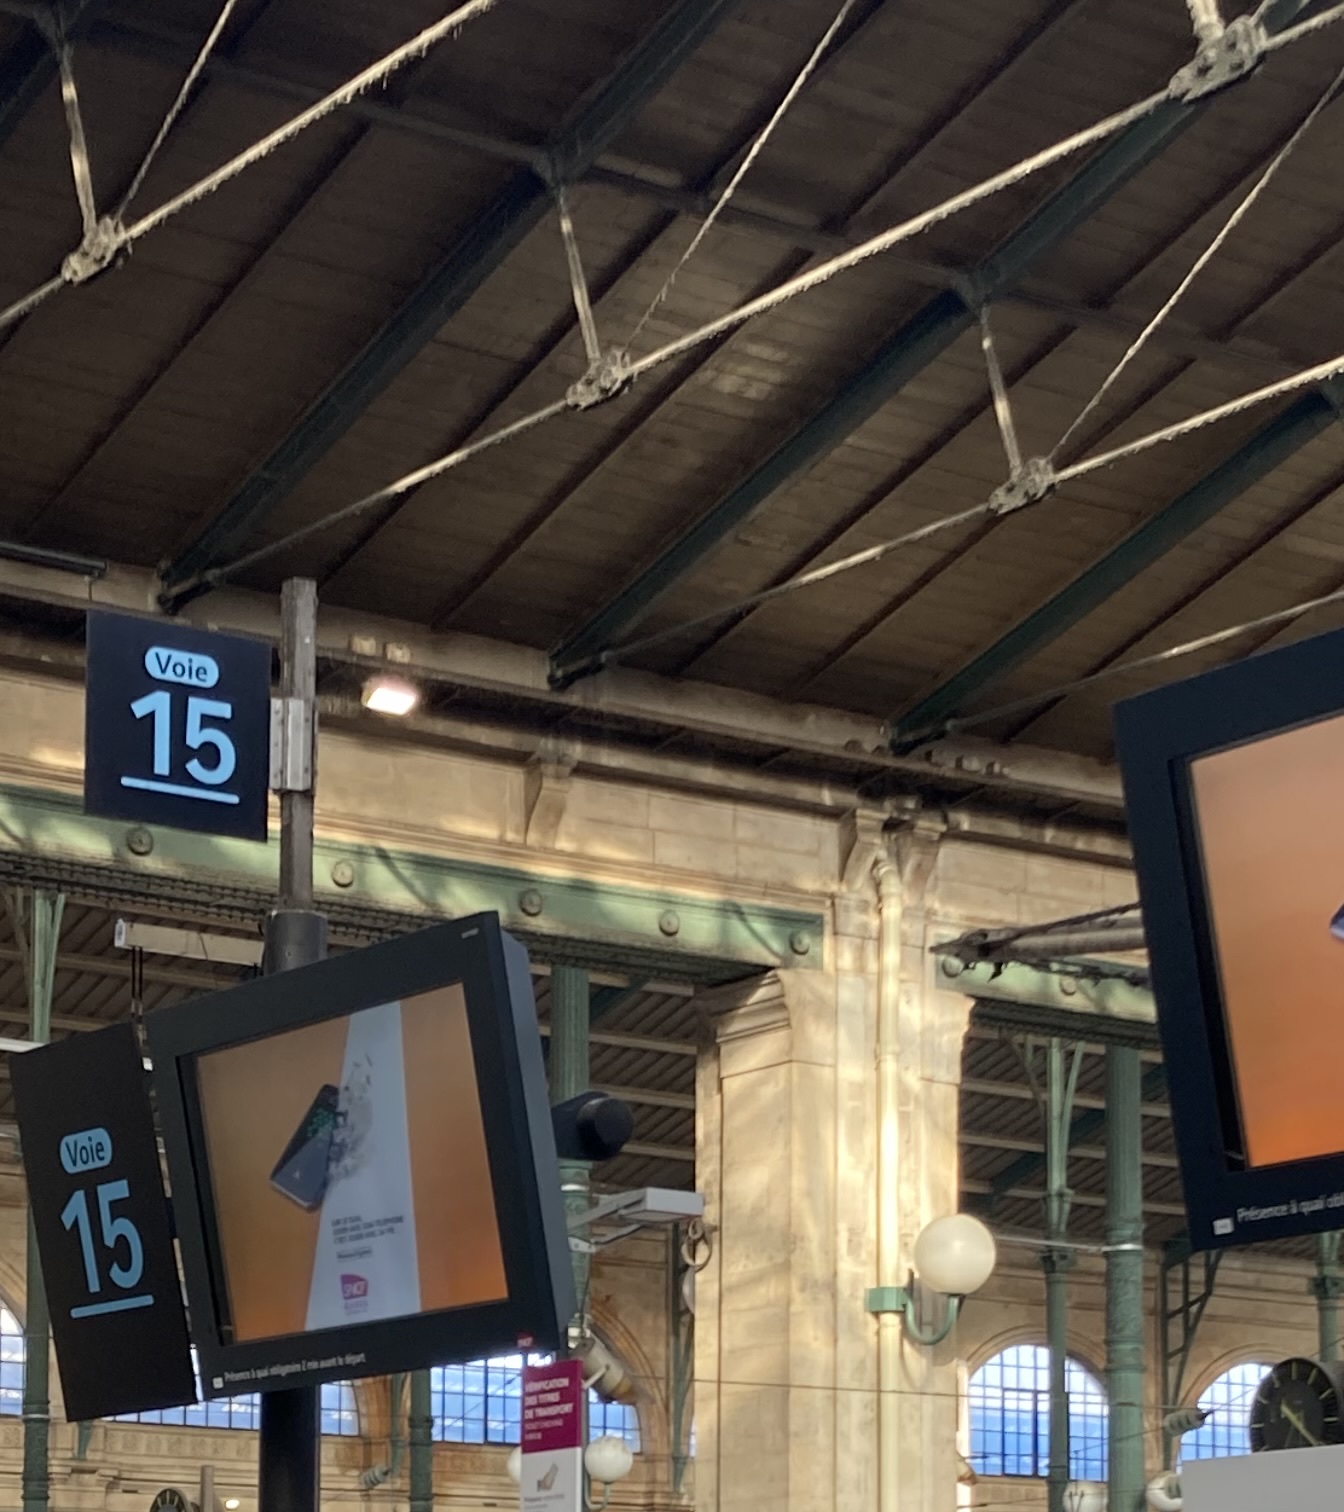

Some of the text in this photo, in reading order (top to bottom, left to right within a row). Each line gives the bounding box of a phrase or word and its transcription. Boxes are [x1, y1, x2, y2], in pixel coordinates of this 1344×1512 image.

[154, 651, 208, 682] Voie
[129, 690, 237, 786] 15
[65, 1135, 106, 1167] Voie
[60, 1178, 145, 1294] 15
